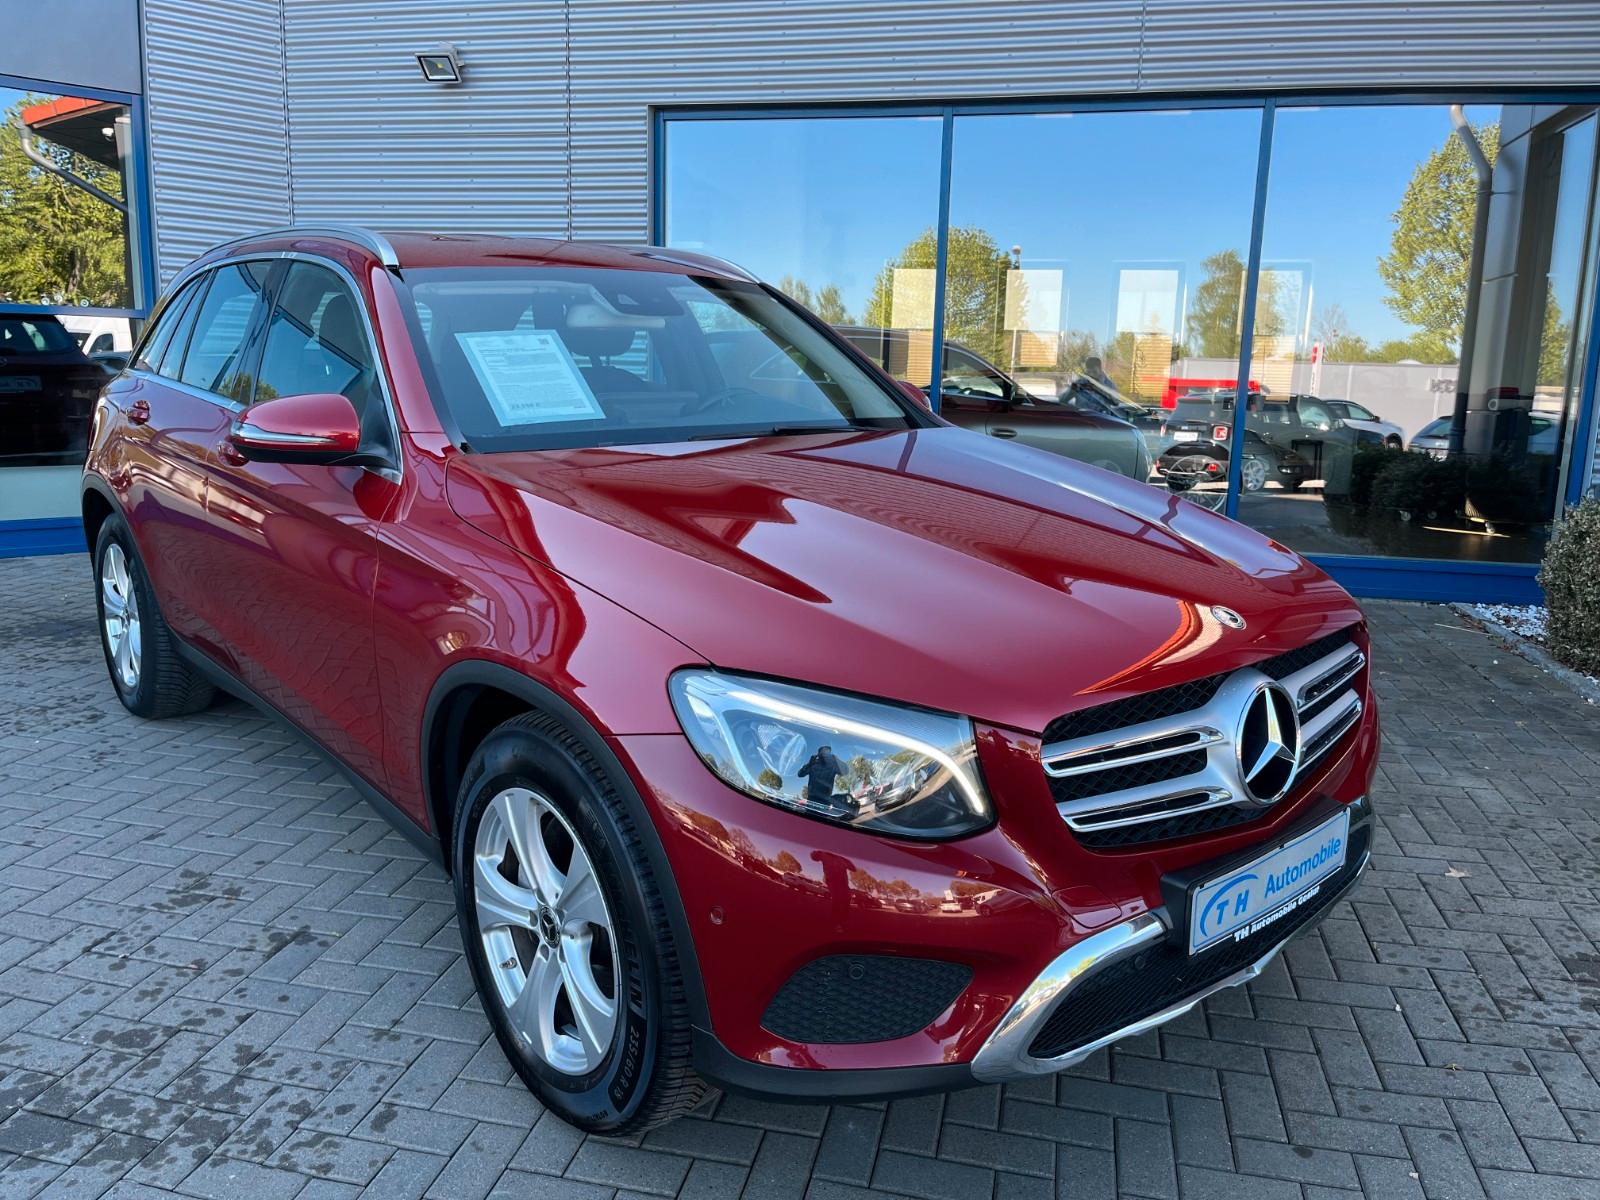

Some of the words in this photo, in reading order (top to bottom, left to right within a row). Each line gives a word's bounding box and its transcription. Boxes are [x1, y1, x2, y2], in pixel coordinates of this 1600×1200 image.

[1263, 836, 1342, 899] Automobile
[1233, 925, 1250, 943] TH
[1250, 902, 1297, 935] Automobile
